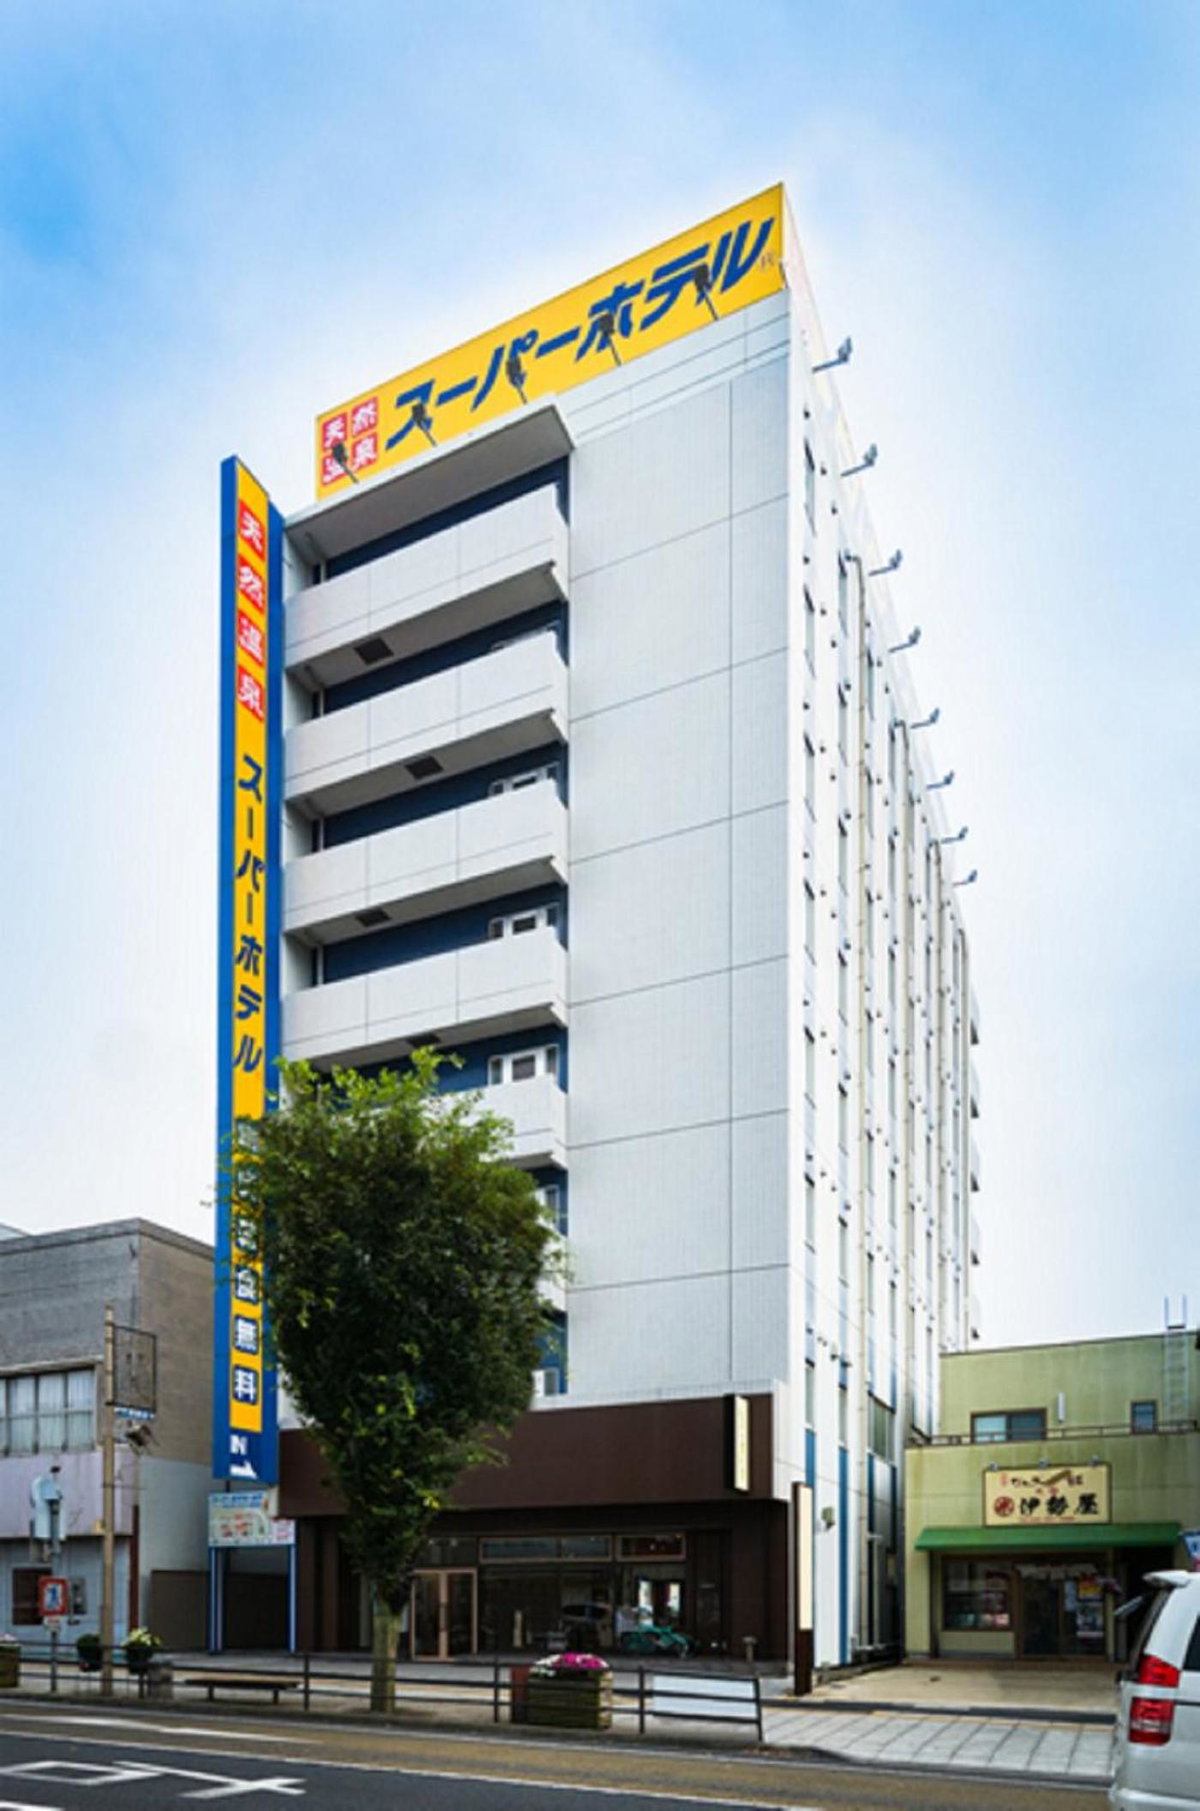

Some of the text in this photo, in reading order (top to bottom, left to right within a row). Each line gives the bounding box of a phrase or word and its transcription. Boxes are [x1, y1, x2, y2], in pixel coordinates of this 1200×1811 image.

[384, 216, 775, 451] スーパーホテル
[239, 508, 264, 721] 天然温泉
[232, 753, 266, 1074] スーパーホテル
